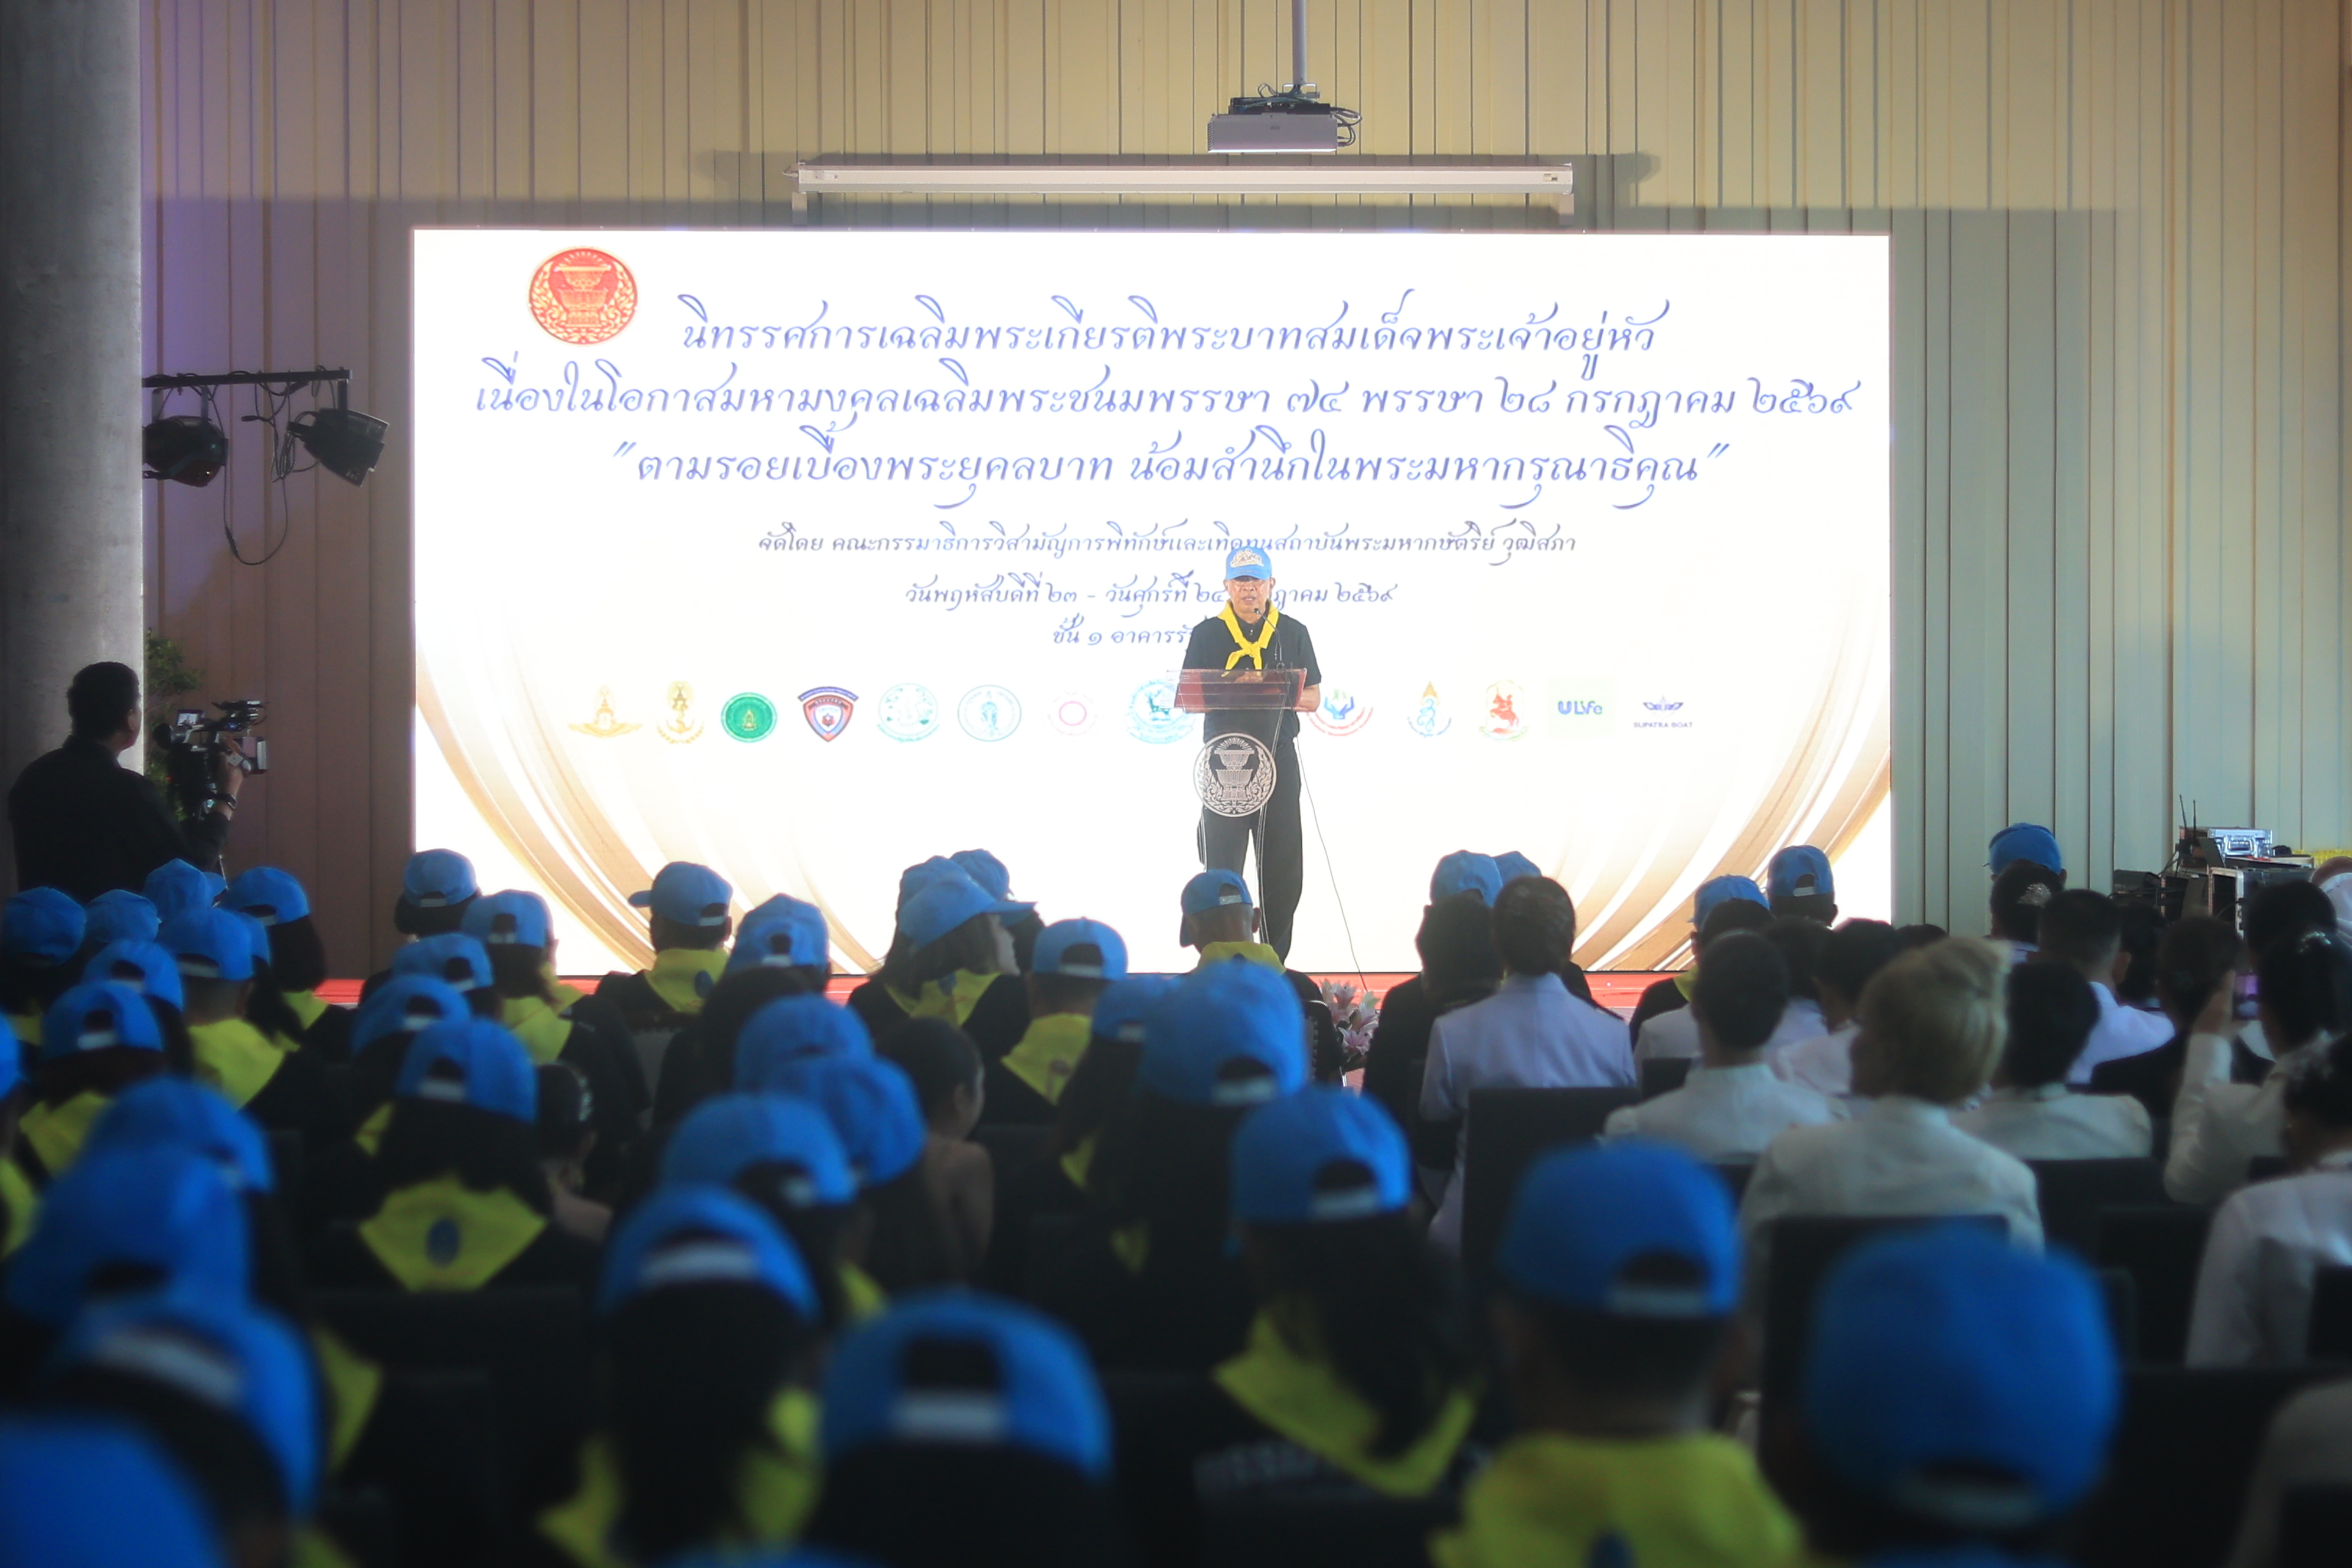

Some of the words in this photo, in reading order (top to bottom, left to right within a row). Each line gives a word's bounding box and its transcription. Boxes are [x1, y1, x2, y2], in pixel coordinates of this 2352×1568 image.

[677, 288, 1671, 381] นิทรรศการเฉลิมพระเกียรติพระบาทสมเด็จพระเจ้าอยู่หัว
[476, 351, 1270, 413] เนื่องในโอกาสมหามงคลเฉลิมพระชนมพรรษา
[1287, 378, 1350, 413] ๗๔
[1362, 390, 1483, 413] พรรษา
[1494, 375, 1557, 413] ๒๘
[1566, 389, 1736, 429] กรกฎาคม
[1746, 377, 1861, 413] ๒๕๖๙
[759, 521, 824, 551] จัดโดย
[1488, 520, 1576, 566] วุฒิสภา
[906, 571, 1043, 611] วันพฤหัสบดีที่
[1046, 582, 1077, 602] ๒๓
[1106, 570, 1194, 618] วันศุกร์ที่
[1334, 582, 1398, 603] ๒๕๖๙
[1053, 612, 1084, 644] ชั้น
[1087, 631, 1103, 646] ๑
